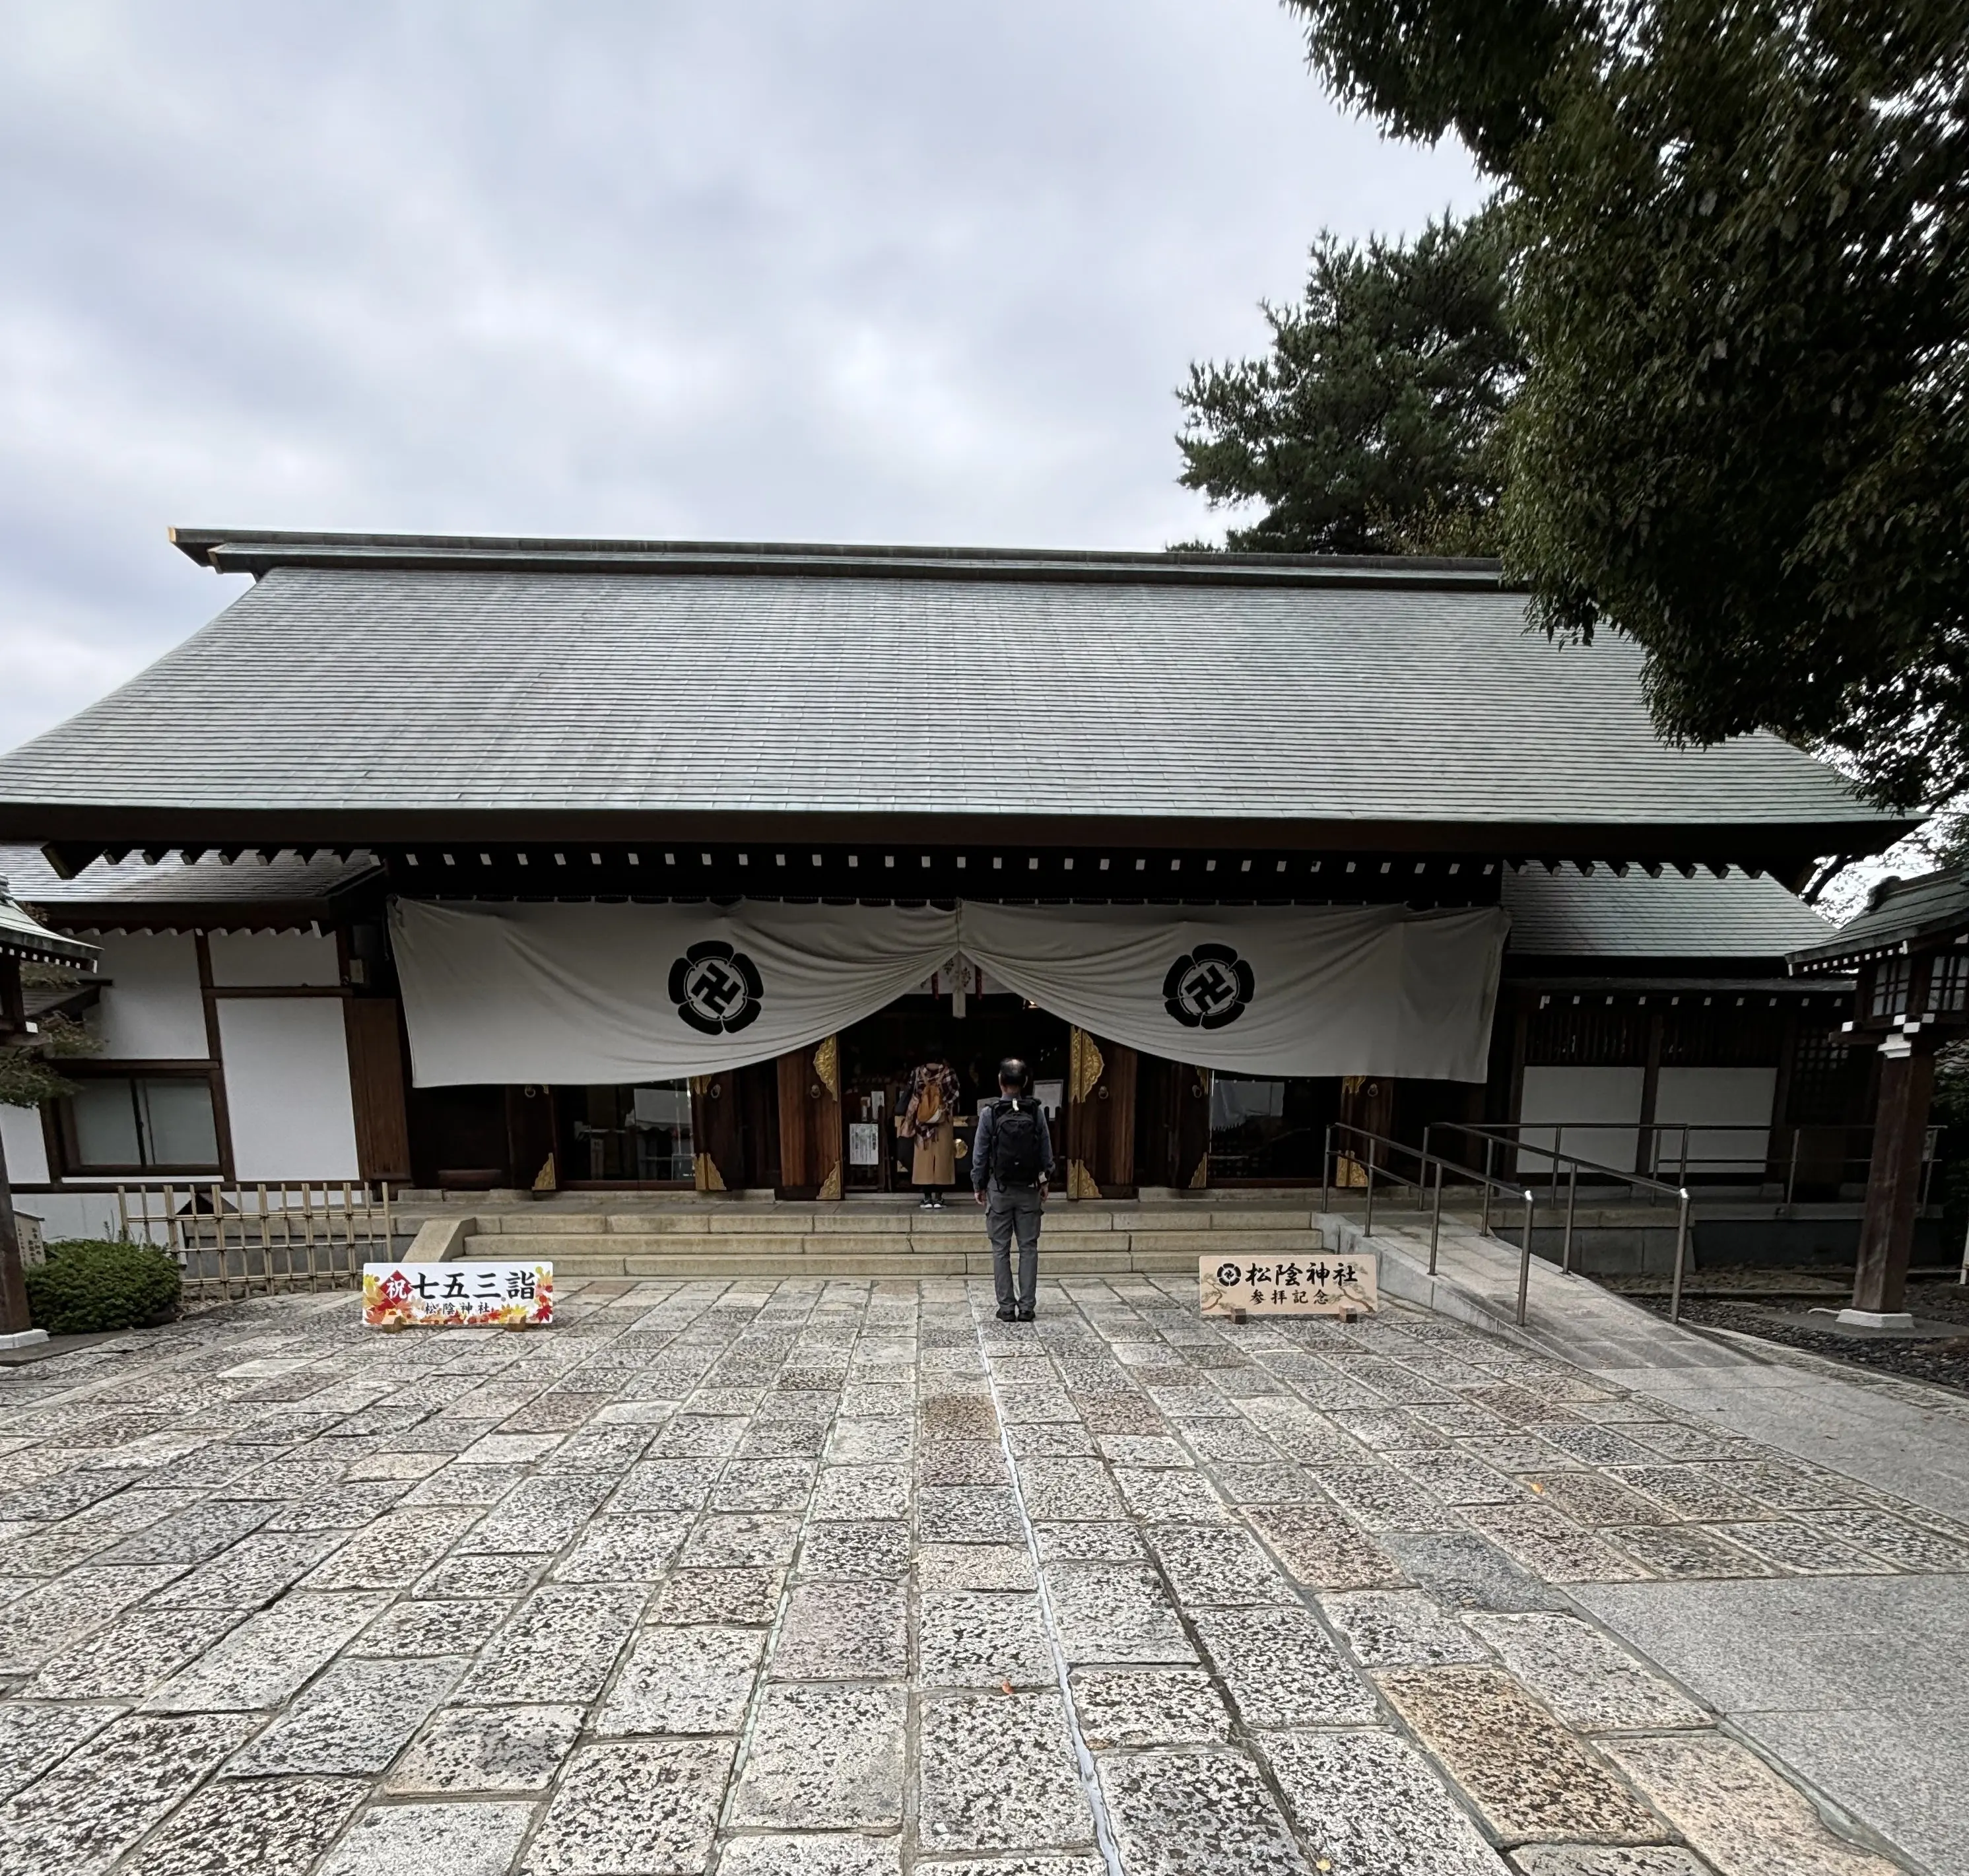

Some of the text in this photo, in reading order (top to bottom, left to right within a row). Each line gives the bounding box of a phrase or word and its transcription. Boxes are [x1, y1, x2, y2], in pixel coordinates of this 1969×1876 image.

[385, 1270, 535, 1300] 祝 七五三詣
[1245, 1261, 1358, 1287] 松陰神社
[425, 1302, 490, 1315] 松陰神社
